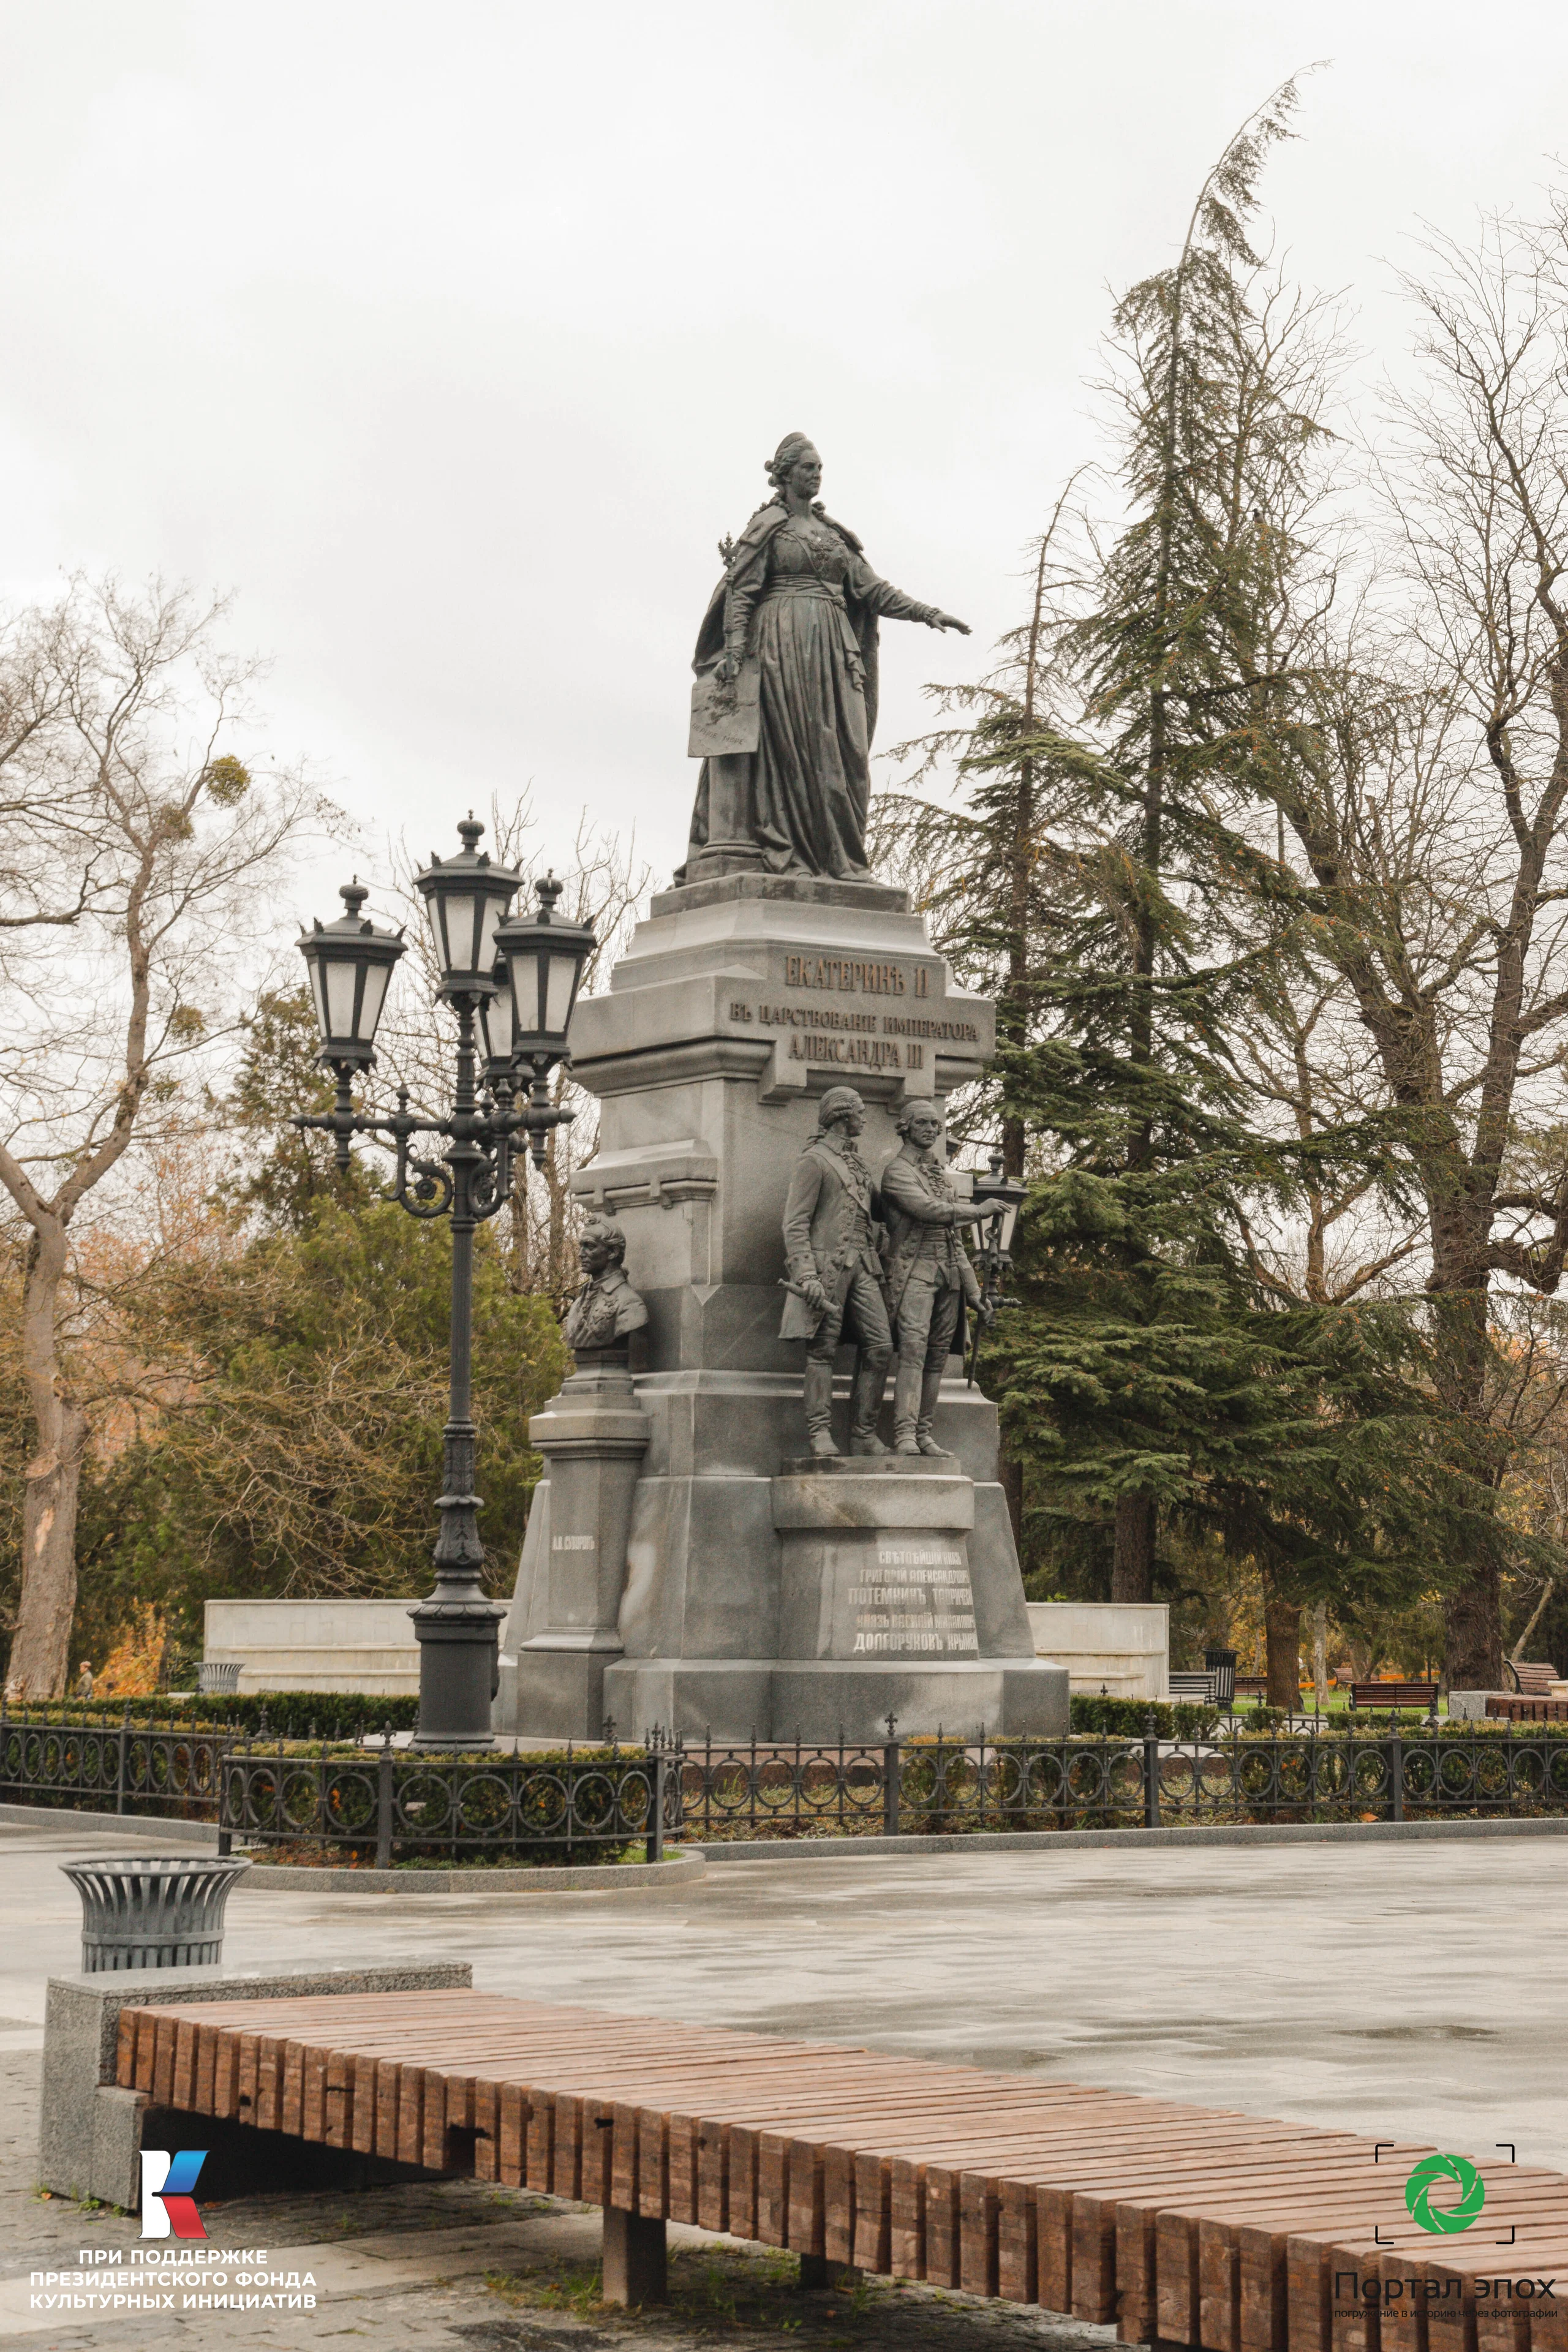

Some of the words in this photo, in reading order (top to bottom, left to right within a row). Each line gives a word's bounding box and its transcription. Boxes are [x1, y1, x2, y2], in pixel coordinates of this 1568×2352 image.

[915, 967, 930, 998] II
[730, 1002, 752, 1022] ВЪ
[883, 1016, 979, 1041] ИМПЕРАТОРА
[789, 1034, 901, 1071] АЛЕКСАНДРА
[907, 1043, 925, 1069] III
[853, 1632, 943, 1653] ДОЛГОРУКОВЪ
